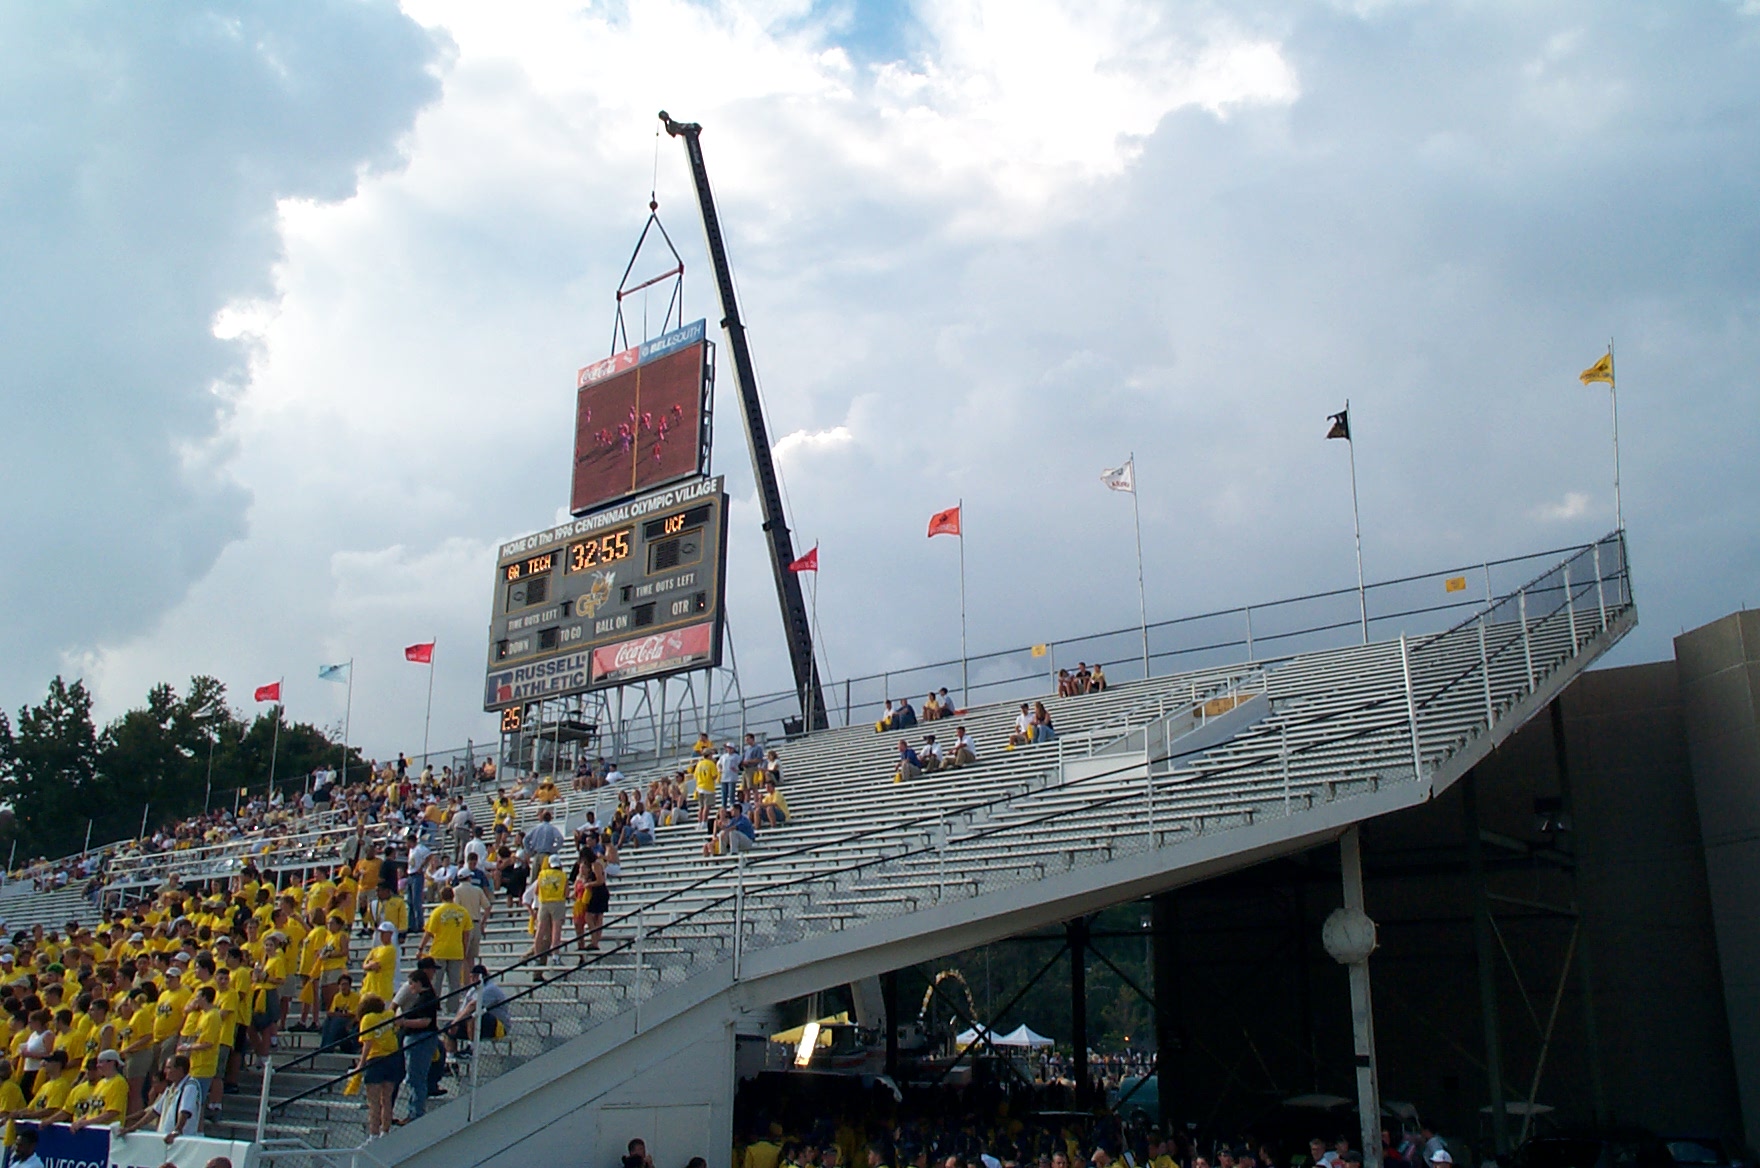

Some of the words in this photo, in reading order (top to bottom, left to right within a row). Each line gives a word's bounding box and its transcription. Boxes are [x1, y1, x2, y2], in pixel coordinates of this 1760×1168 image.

[503, 539, 526, 557] HOME
[554, 524, 573, 540] 1996
[575, 507, 629, 534] CENTENNIAL
[631, 492, 673, 516] OLYMPIC
[675, 479, 717, 502] VILLAGE
[664, 514, 685, 534] UCF
[571, 531, 629, 571] 32:55
[528, 554, 551, 574] TECH
[636, 583, 653, 597] TIME
[655, 578, 674, 592] OUTS
[677, 573, 695, 587] LEFT
[542, 609, 558, 622] LEFT
[672, 600, 690, 615] QTR
[561, 629, 570, 642] TO
[571, 625, 582, 639] GO
[595, 618, 614, 634] BALL
[616, 615, 628, 629] ON
[515, 655, 584, 682] RUSSELL
[514, 671, 584, 699] ATHLETIC
[502, 706, 521, 731] 25
